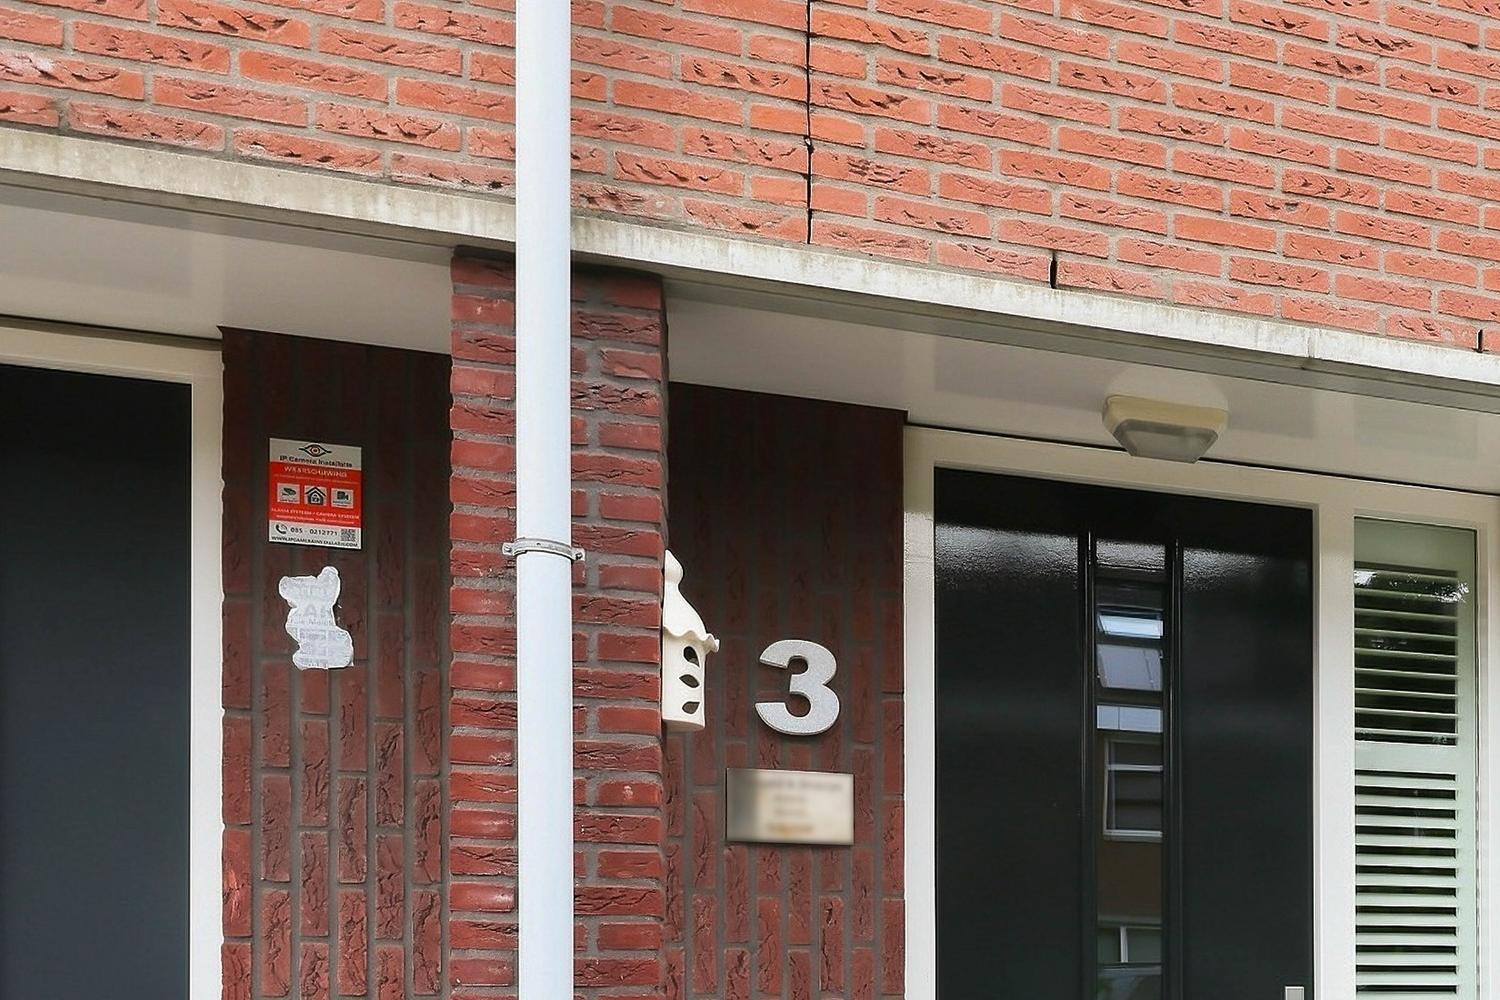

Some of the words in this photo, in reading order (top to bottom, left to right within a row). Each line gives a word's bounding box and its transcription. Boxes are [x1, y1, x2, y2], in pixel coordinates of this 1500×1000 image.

[289, 456, 316, 464] Camera
[284, 466, 347, 477] WAARSCHUWING
[755, 639, 840, 735] 3
